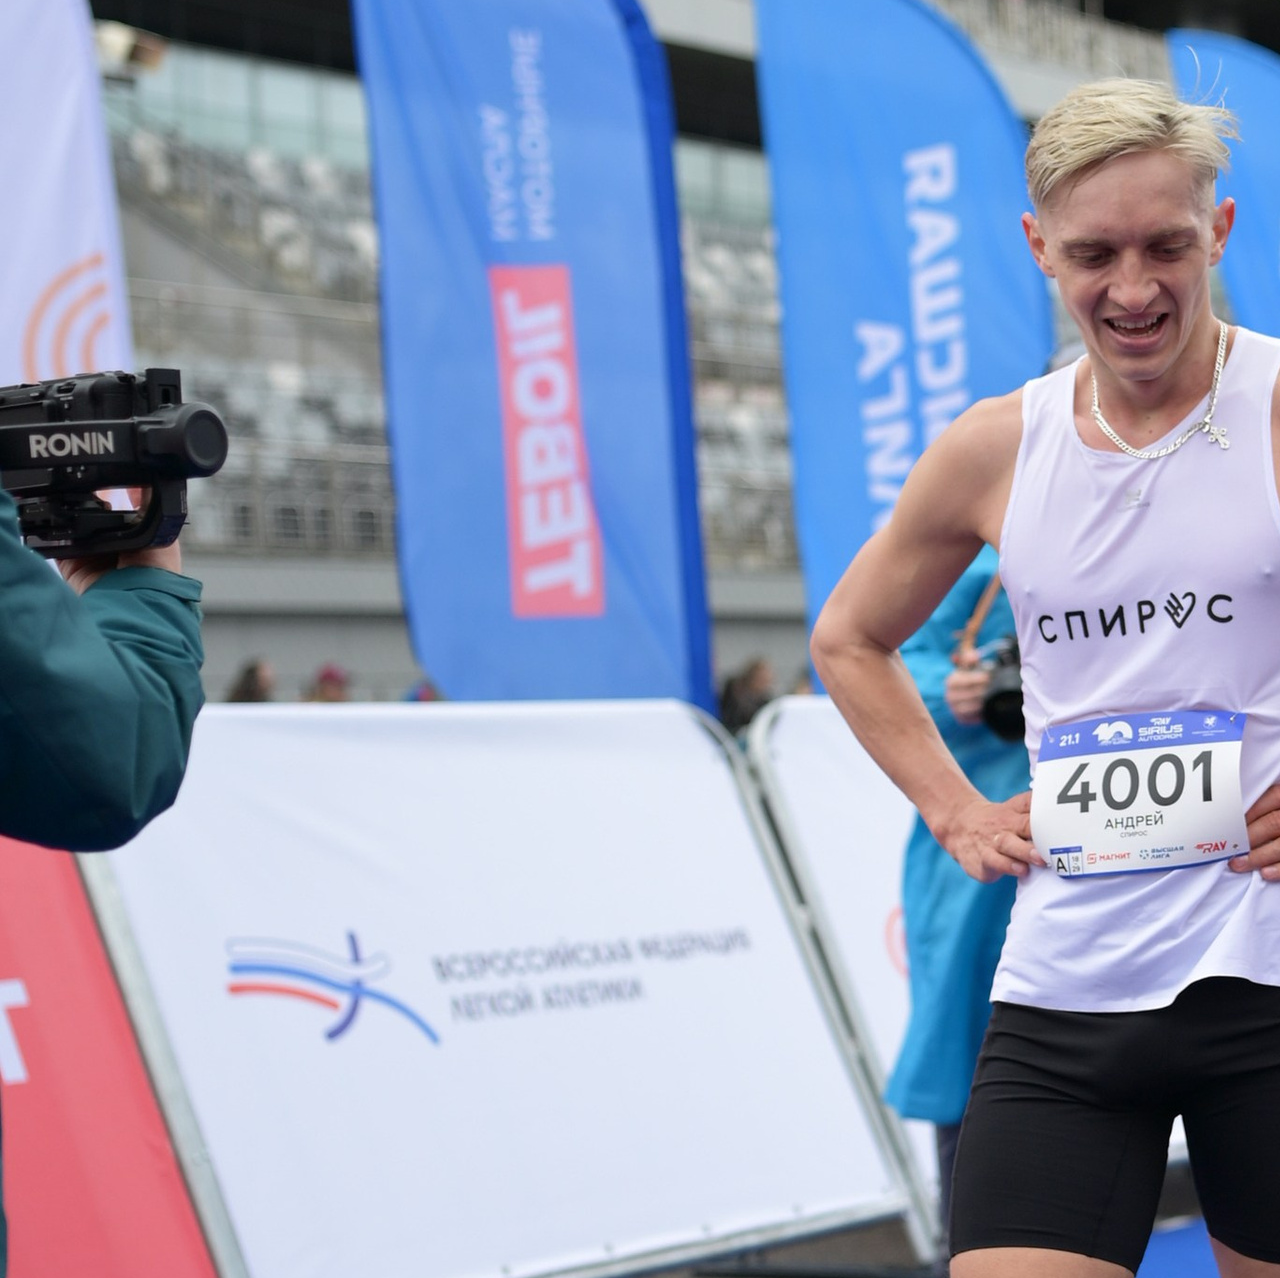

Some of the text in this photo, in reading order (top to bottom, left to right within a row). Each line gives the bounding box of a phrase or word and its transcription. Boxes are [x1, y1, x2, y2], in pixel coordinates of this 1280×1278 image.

[29, 430, 114, 458] RONIN
[1138, 724, 1183, 737] SIRIUS
[1059, 733, 1081, 747] 21.1
[1137, 733, 1183, 742] AUTODROM
[1057, 750, 1212, 813] 4001
[1104, 810, 1164, 829] АНДРЕЙ
[1119, 829, 1148, 838] СПИРОС
[1151, 845, 1184, 853] ВЫСШАЯ
[1194, 840, 1227, 854] RAY
[1099, 852, 1131, 862] МАГНИТ
